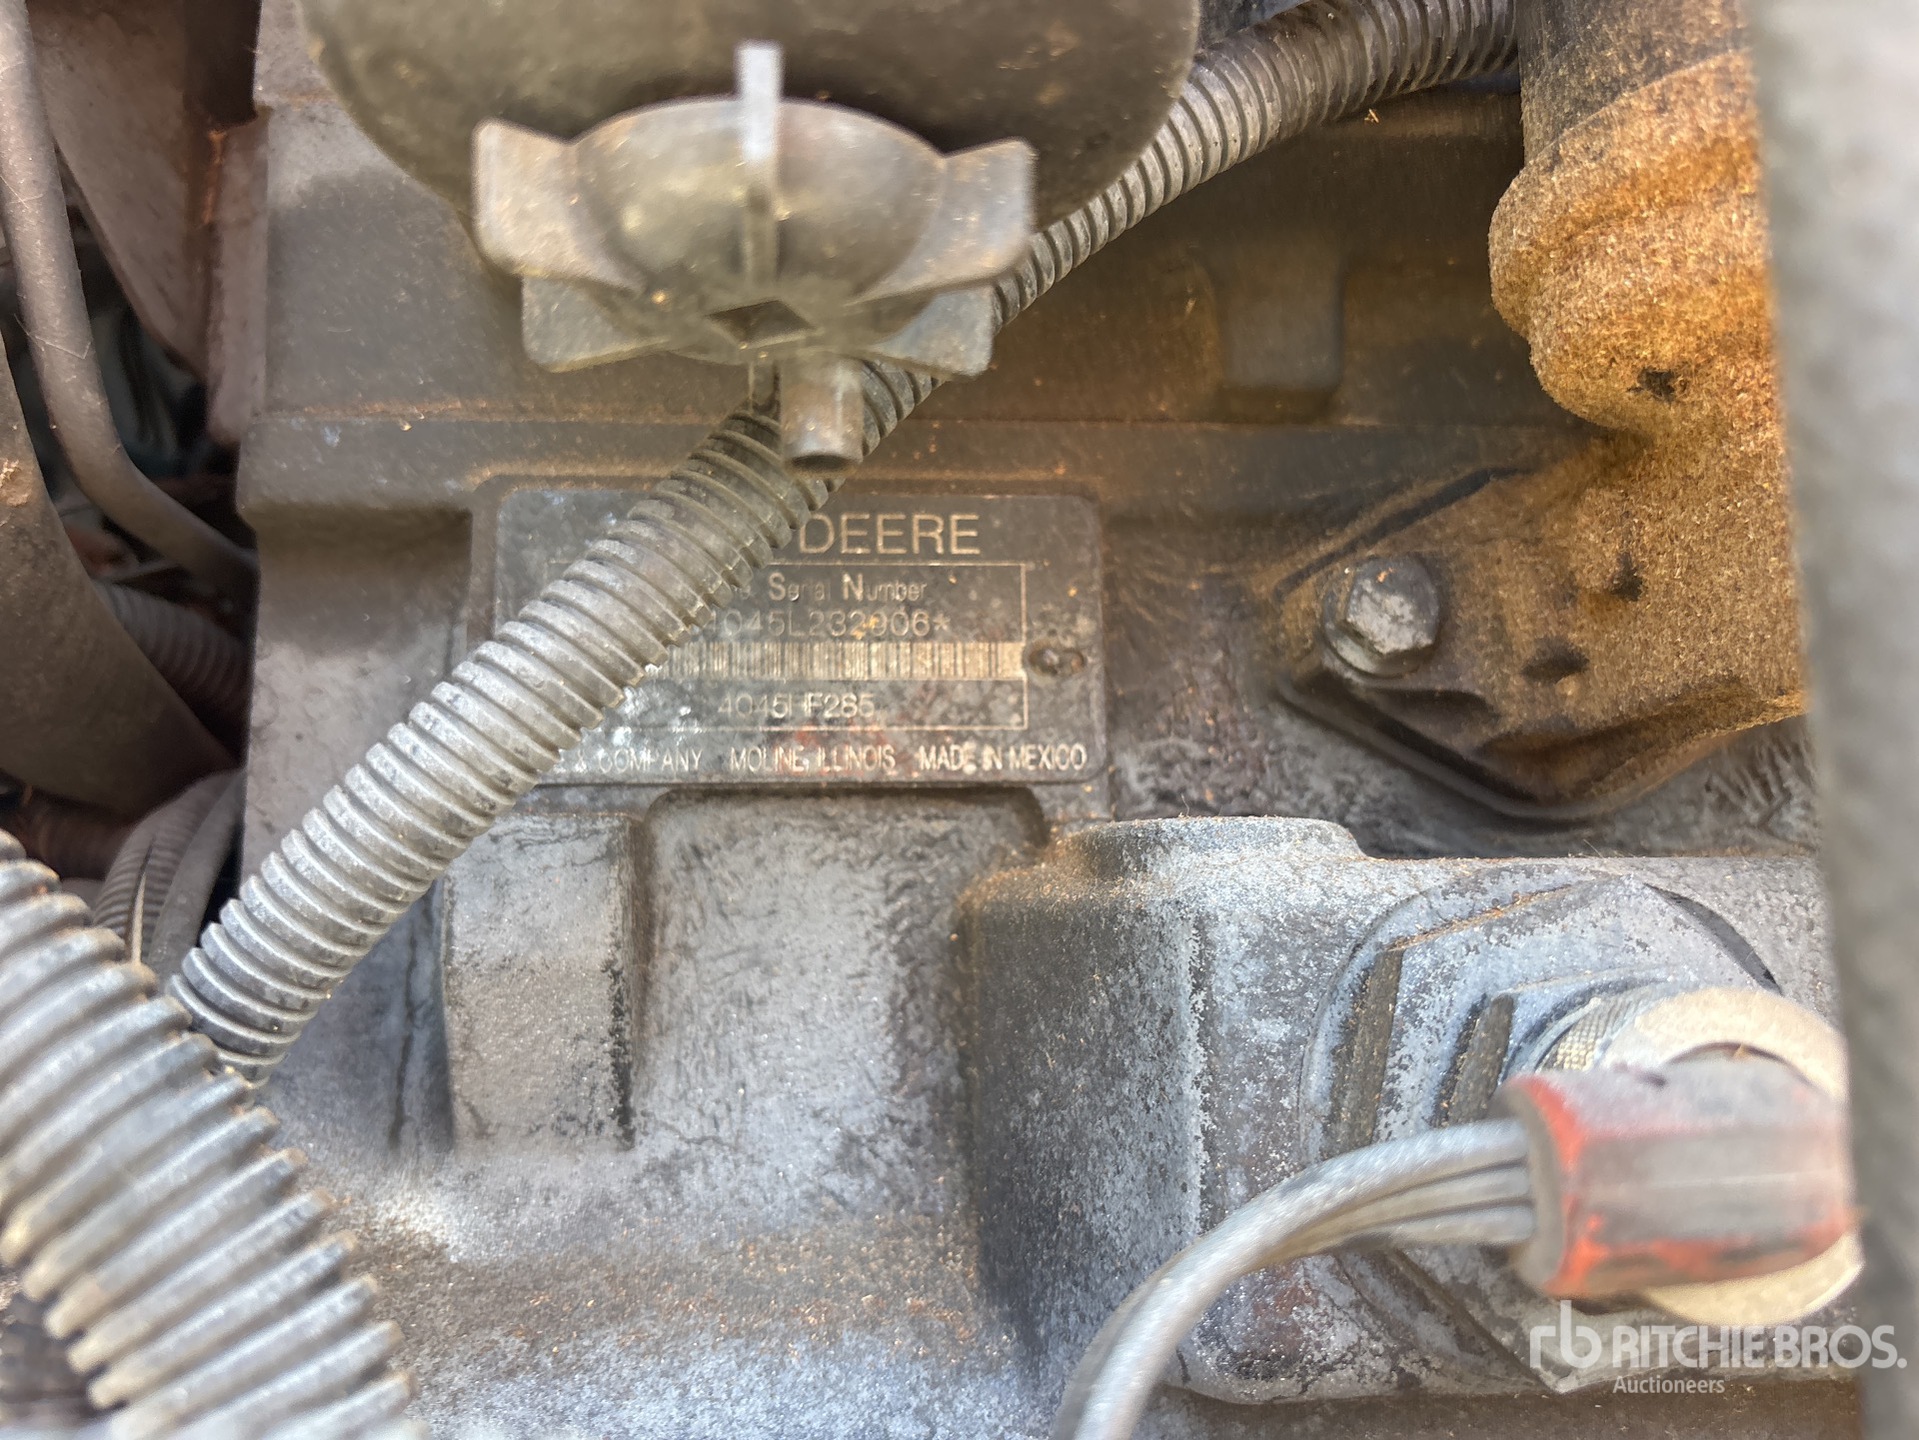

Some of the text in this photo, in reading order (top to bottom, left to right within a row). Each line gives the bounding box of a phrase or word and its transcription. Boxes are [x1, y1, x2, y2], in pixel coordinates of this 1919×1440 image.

[800, 513, 981, 556] DEERE
[768, 572, 831, 601] Serial
[842, 573, 927, 601] Number
[599, 747, 702, 774] COMPANY
[816, 744, 896, 772] ILLINOIS
[918, 742, 976, 773] MADE
[982, 743, 1003, 771] IN
[1009, 742, 1088, 771] MEXICO
